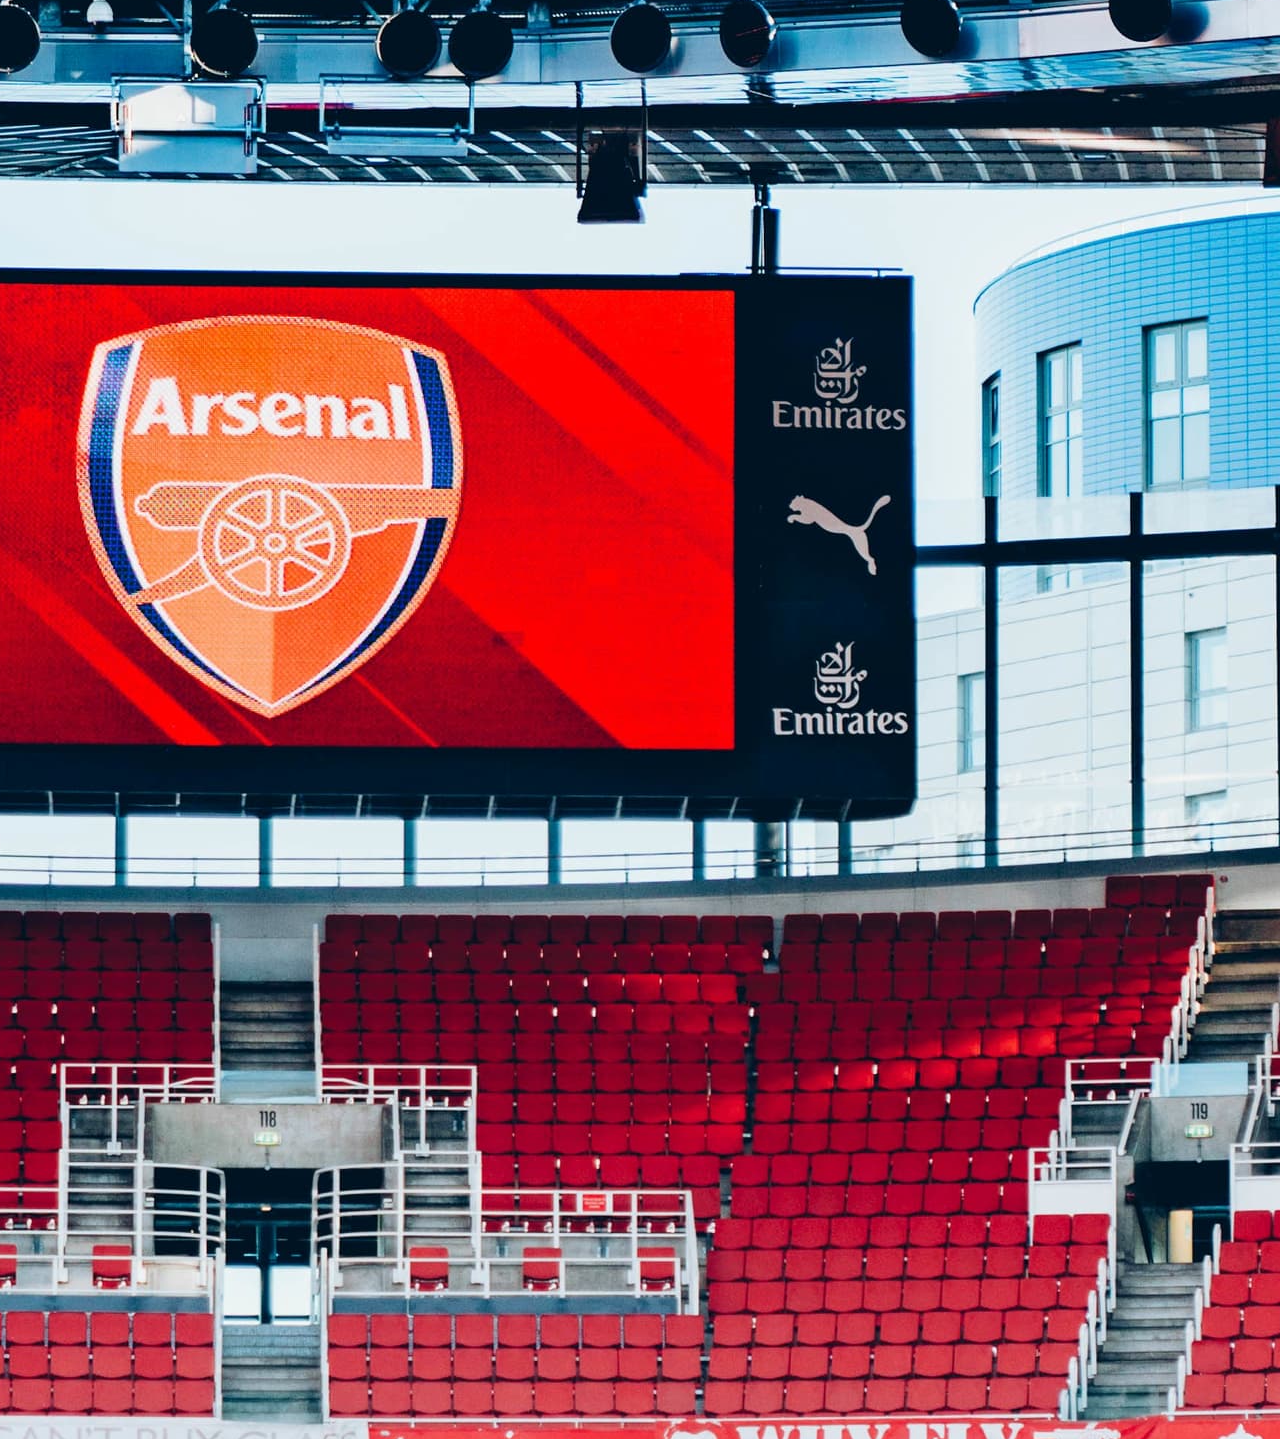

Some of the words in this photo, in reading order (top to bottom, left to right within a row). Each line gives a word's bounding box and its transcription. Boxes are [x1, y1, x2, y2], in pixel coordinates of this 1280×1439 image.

[130, 376, 412, 441] Arsenal
[771, 400, 907, 430] Emirates
[772, 707, 909, 736] Emirates
[259, 1110, 277, 1128] 118
[1190, 1102, 1209, 1119] 119
